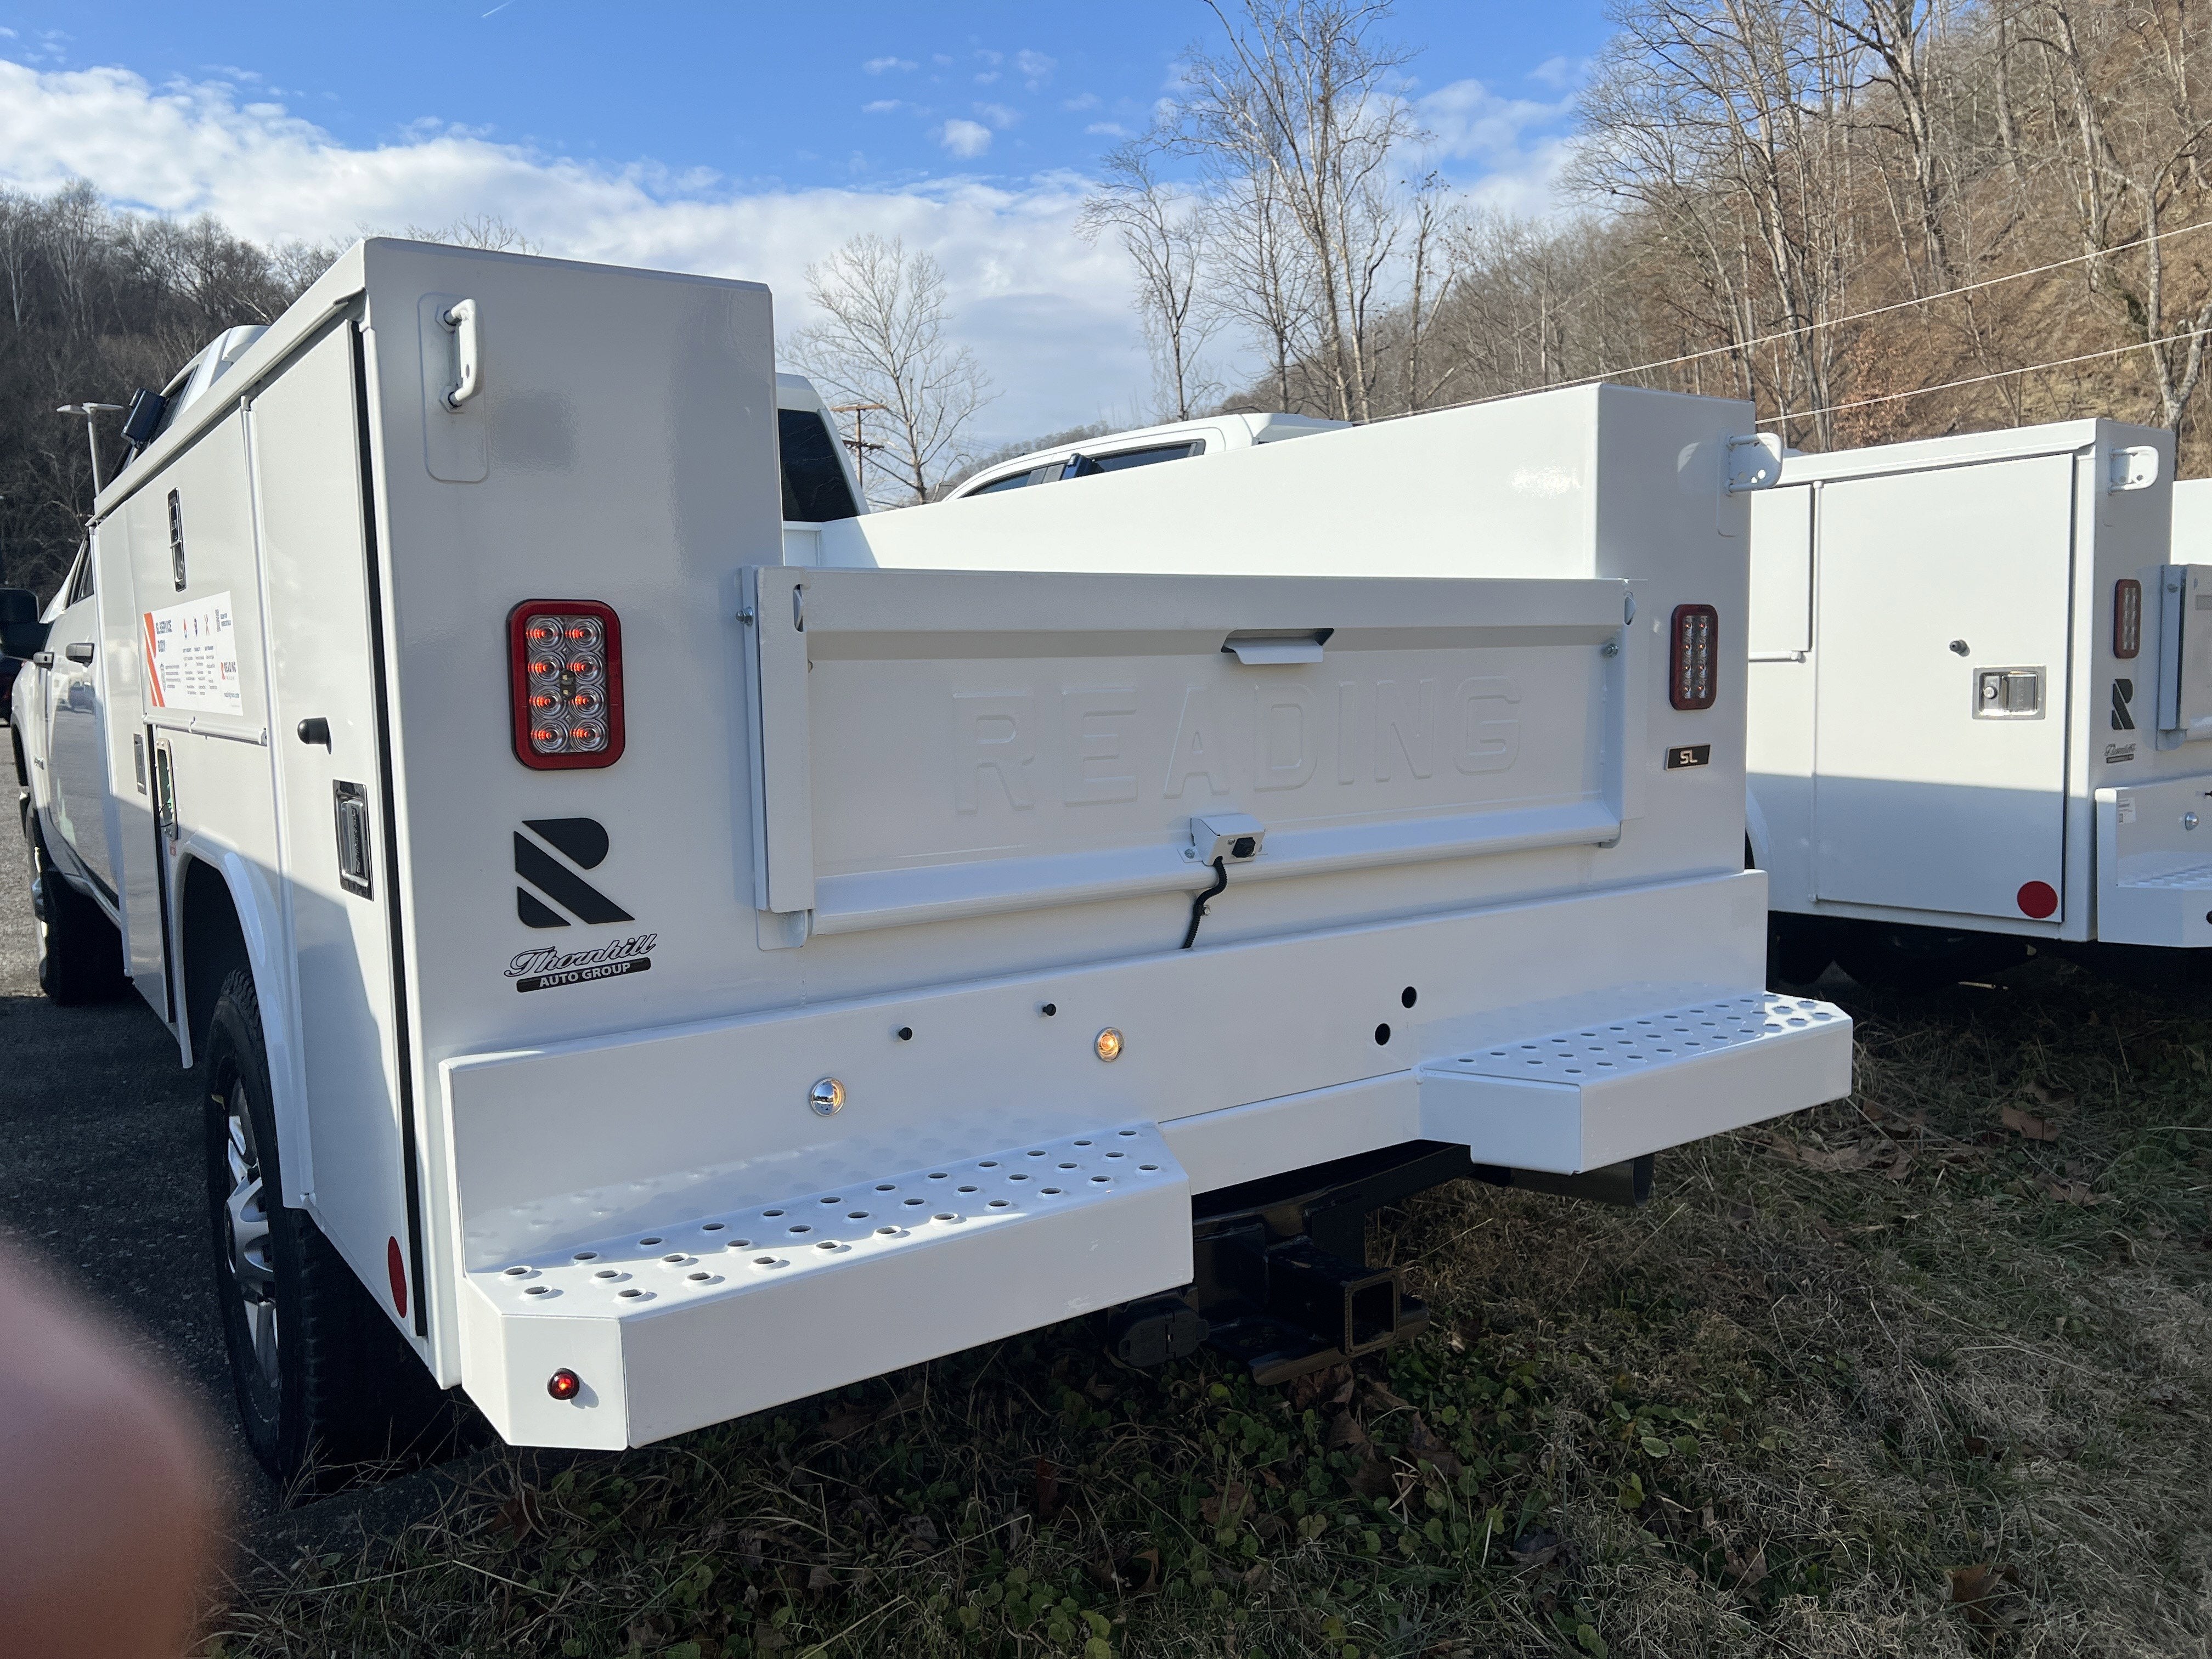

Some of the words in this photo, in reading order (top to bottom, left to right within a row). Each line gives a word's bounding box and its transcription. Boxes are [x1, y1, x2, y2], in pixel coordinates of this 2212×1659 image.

[953, 676, 1521, 814] READING
[1680, 749, 1698, 764] SL
[504, 933, 658, 978] Thornhill
[539, 971, 579, 988] AUTO
[582, 962, 631, 981] GROUP
